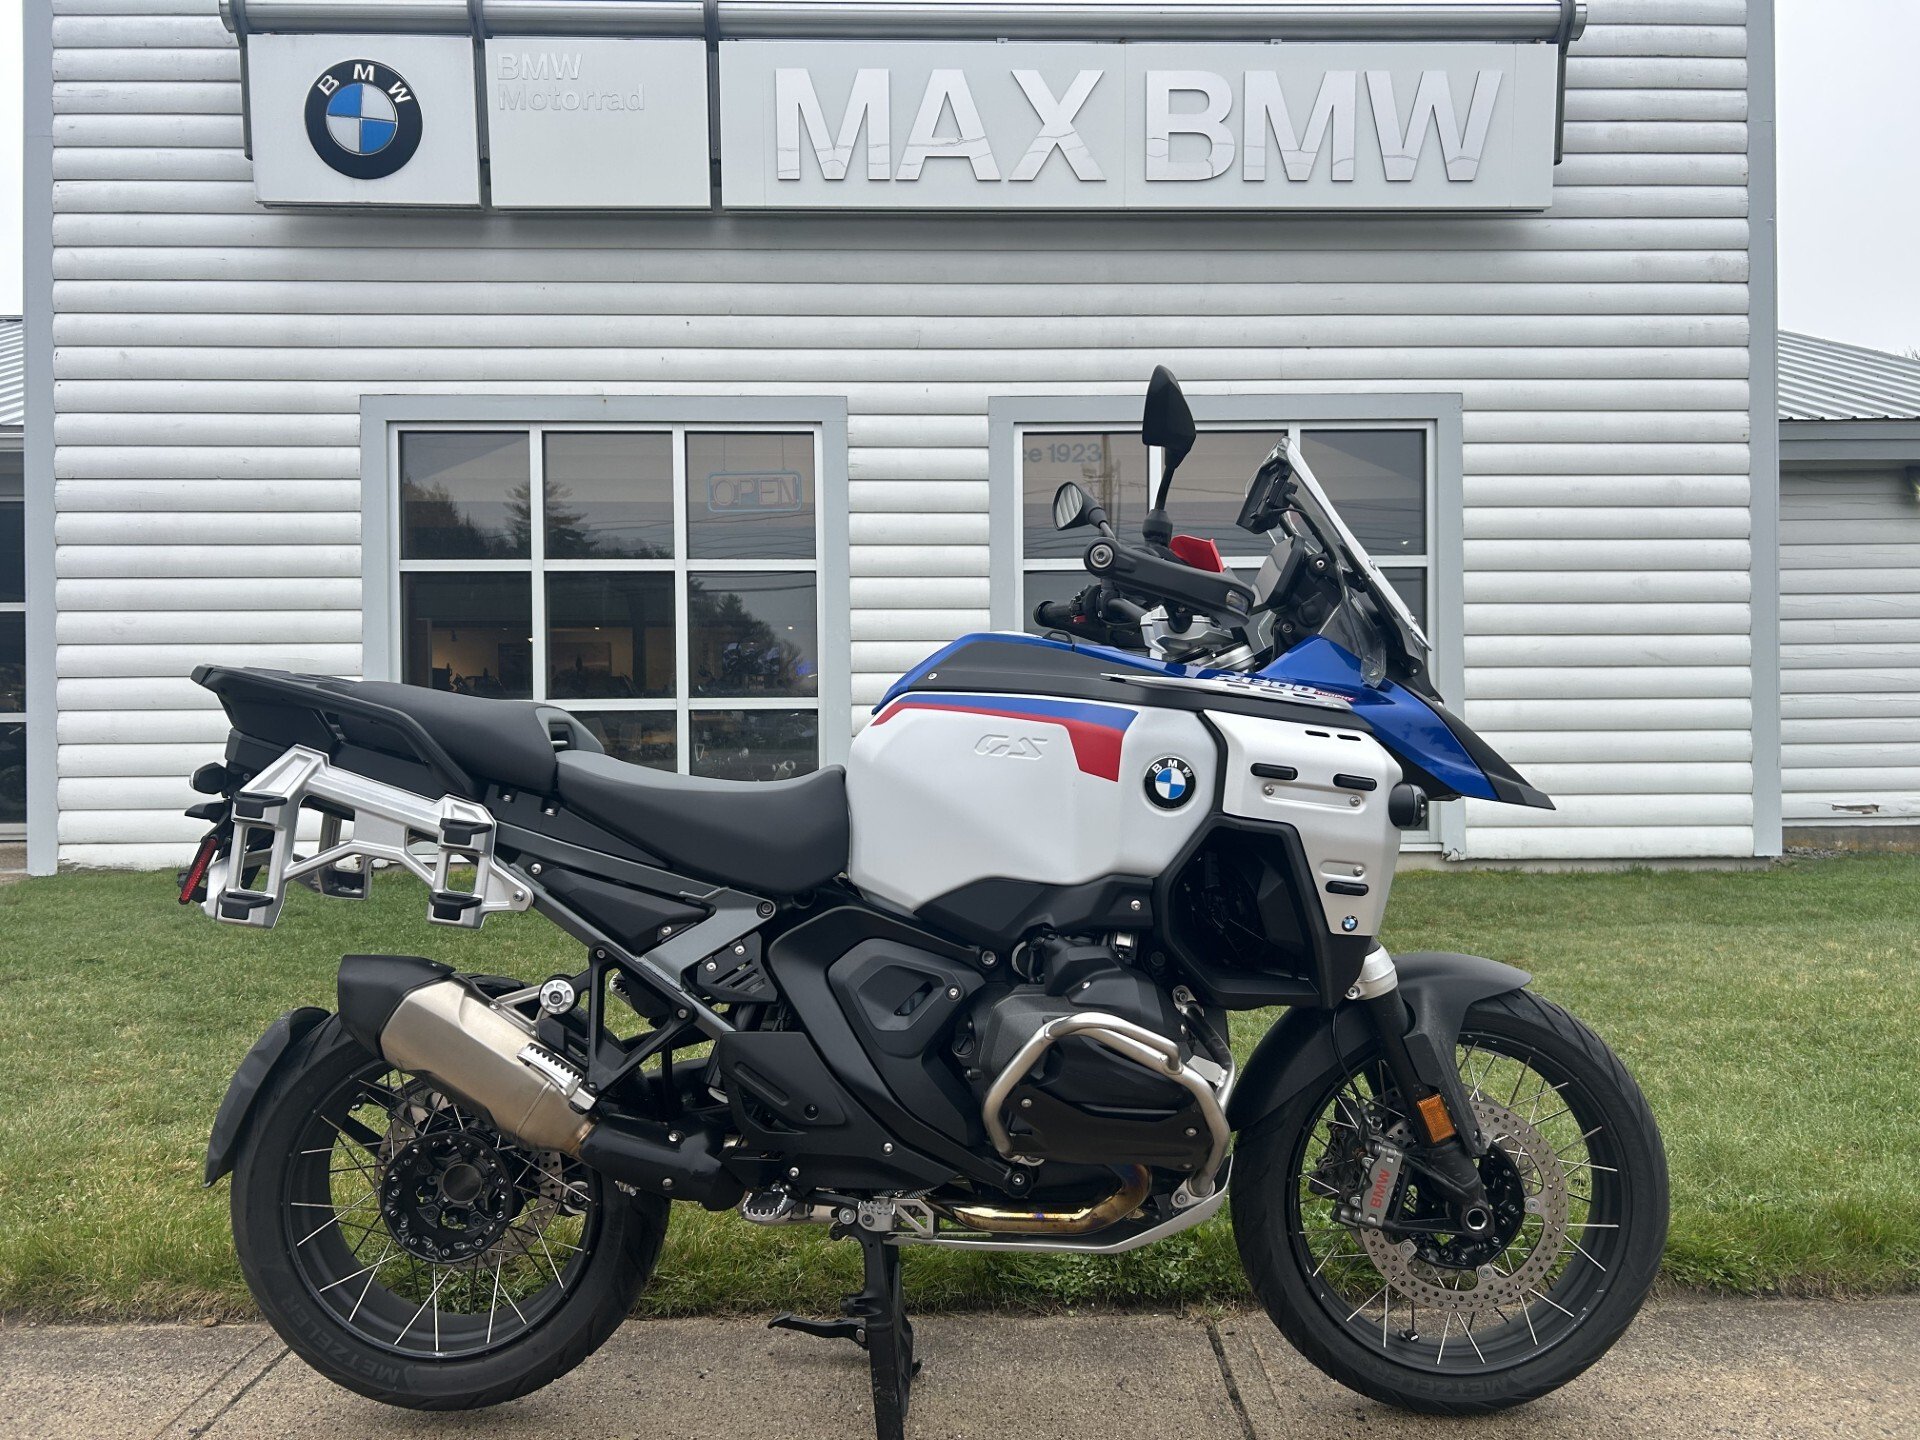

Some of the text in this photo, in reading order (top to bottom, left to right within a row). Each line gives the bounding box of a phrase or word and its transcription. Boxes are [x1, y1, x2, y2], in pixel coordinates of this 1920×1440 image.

[496, 53, 584, 81] BMW
[316, 62, 413, 106] BMW
[498, 84, 646, 112] Motorrad
[775, 68, 1503, 182] MAX BMW
[1049, 443, 1103, 464] 1923
[713, 478, 797, 507] OPEN
[973, 733, 1048, 761] GS
[1151, 758, 1193, 779] BMW
[1370, 1168, 1391, 1209] BMW
